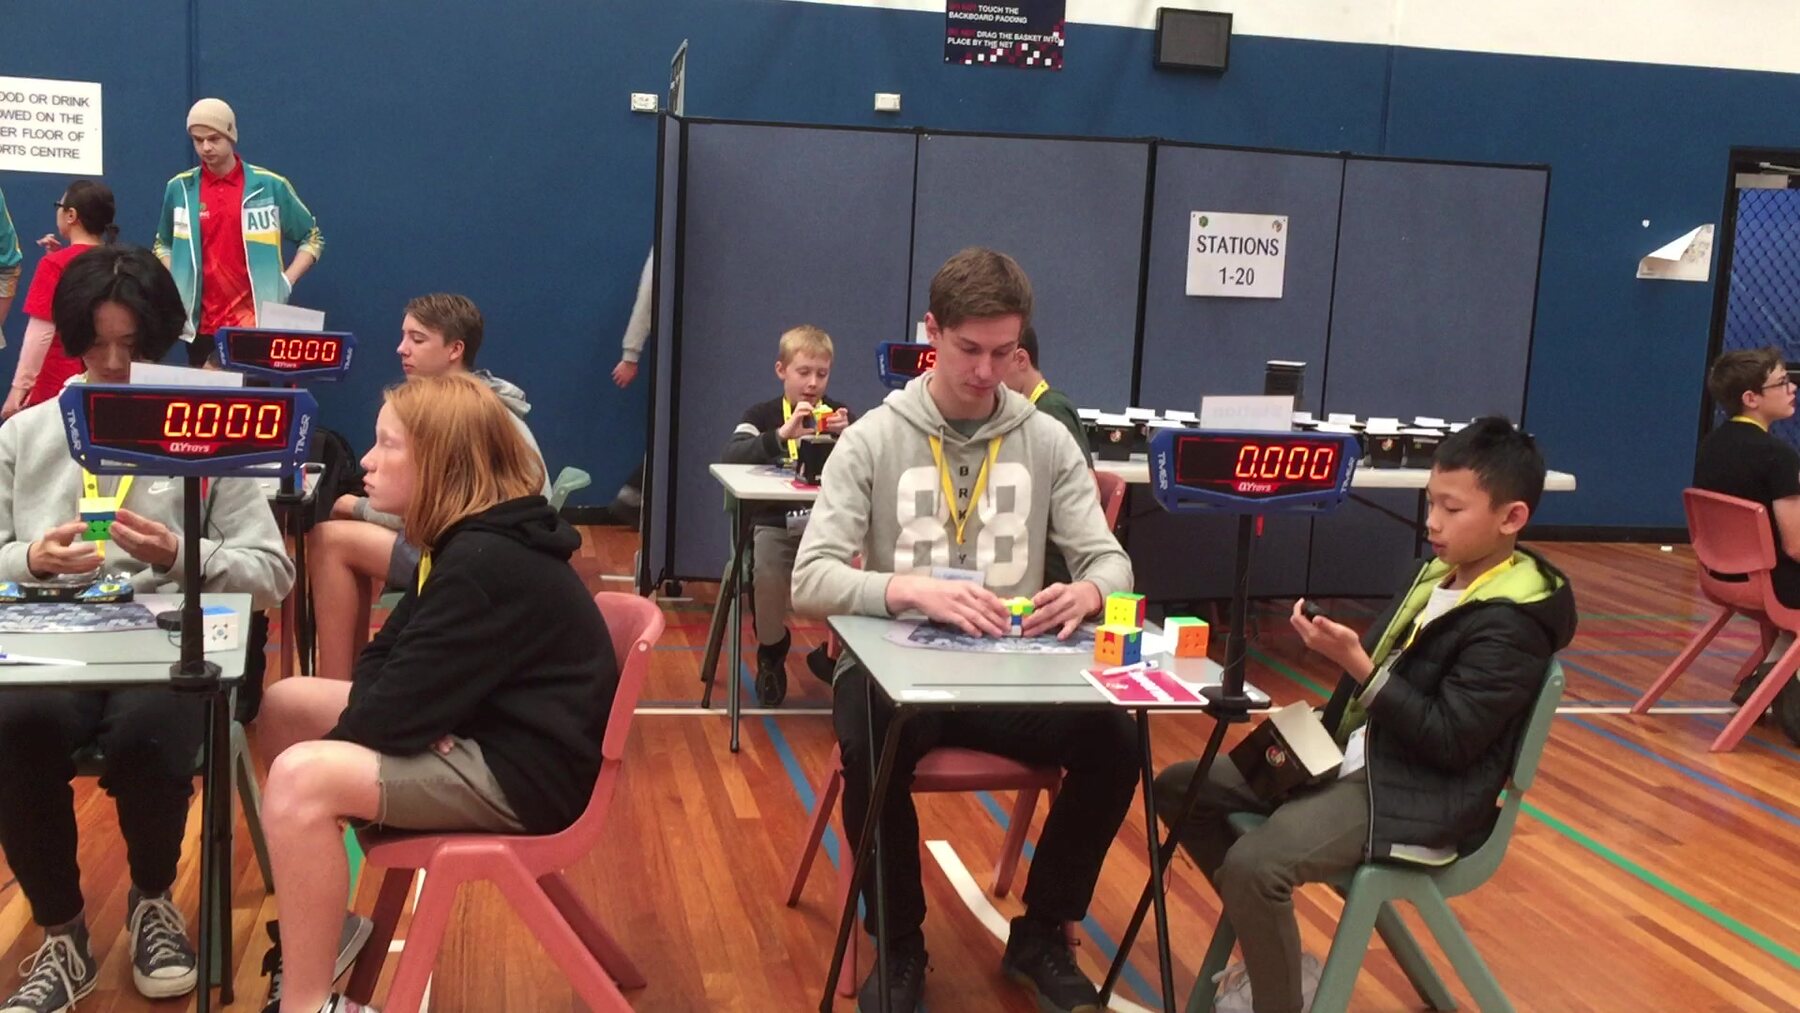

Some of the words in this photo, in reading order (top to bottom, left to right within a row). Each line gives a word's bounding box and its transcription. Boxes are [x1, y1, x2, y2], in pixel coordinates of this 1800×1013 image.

[978, 5, 1003, 14] TOUCH
[1005, 7, 1019, 15] THE
[998, 32, 1013, 40] THE
[999, 41, 1014, 49] NET
[29, 93, 48, 105] OR
[52, 95, 90, 107] DRINK
[36, 111, 55, 122] ON
[60, 113, 84, 124] THE
[23, 128, 63, 140] FLOOR
[68, 131, 85, 141] OF
[0, 144, 26, 156] RTS
[30, 146, 80, 159] CENTRE
[1196, 234, 1279, 256] STATIONS
[1219, 266, 1255, 286] 1-20
[270, 338, 337, 361] 0.000
[164, 402, 282, 439] 0.000
[295, 413, 311, 454] TIMER
[1235, 445, 1334, 480] 0.000
